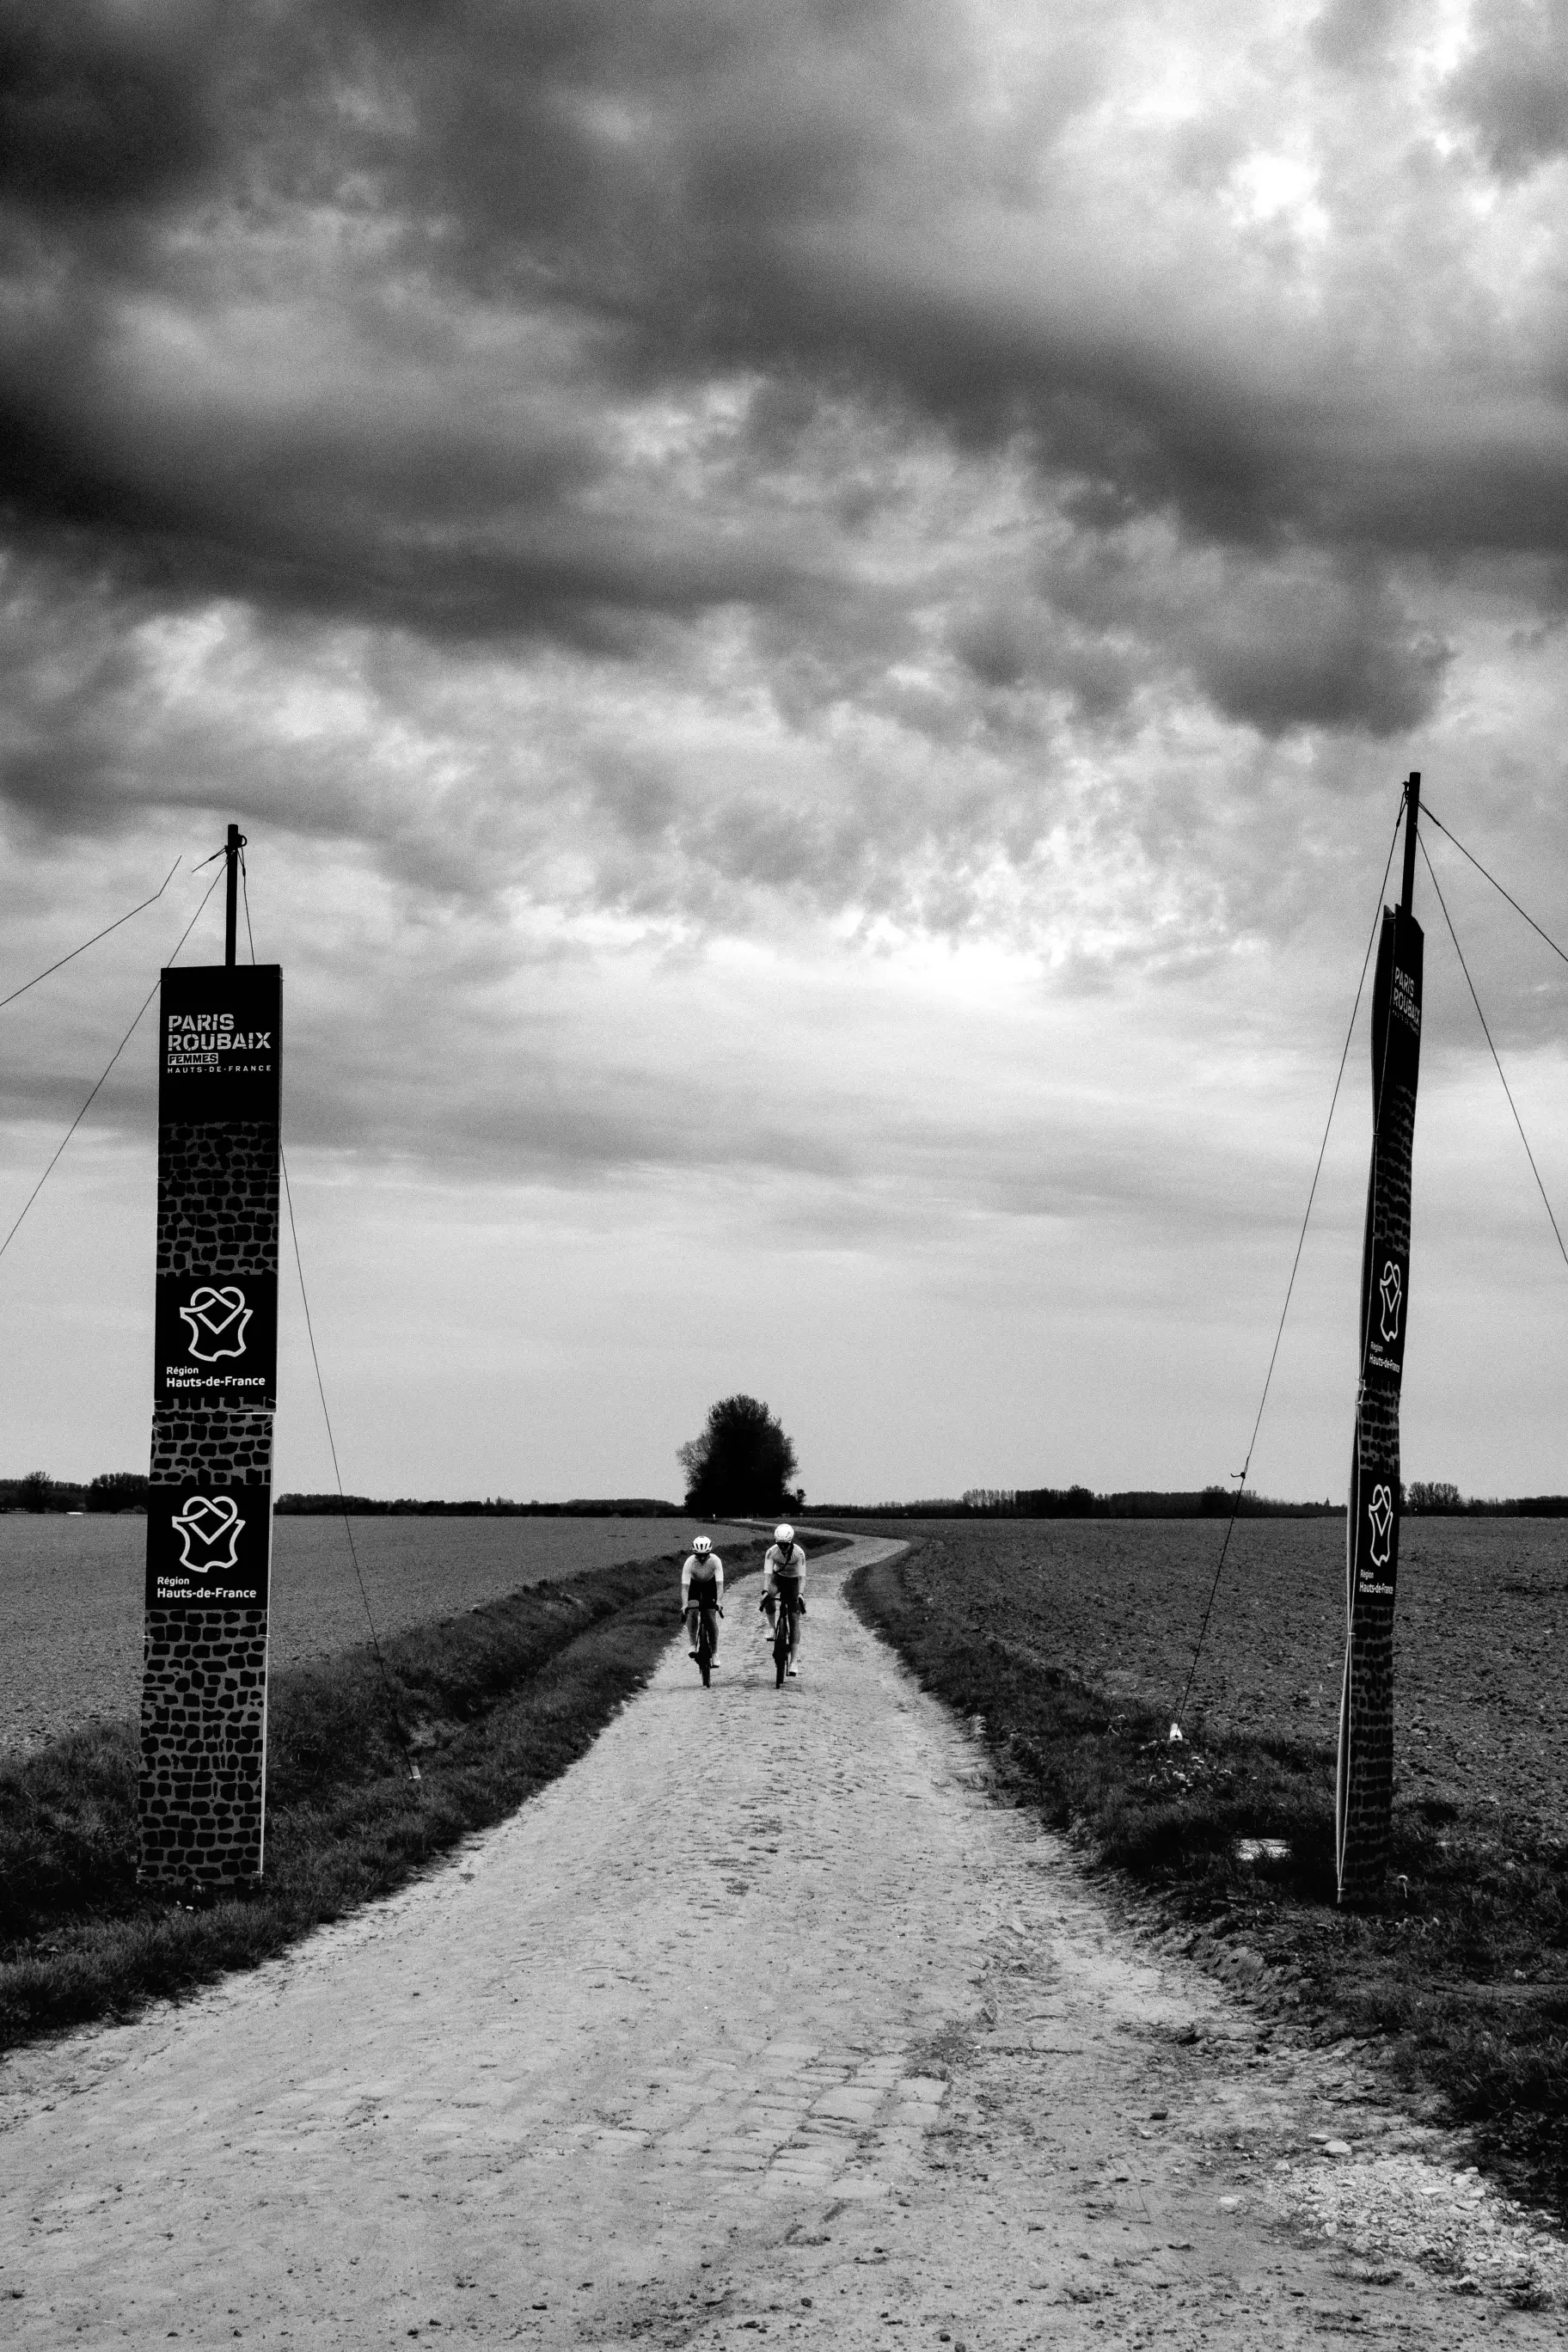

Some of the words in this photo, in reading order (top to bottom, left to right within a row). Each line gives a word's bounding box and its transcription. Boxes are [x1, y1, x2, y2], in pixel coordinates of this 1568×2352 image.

[1394, 966, 1414, 997] PARIS
[168, 1014, 235, 1032] PARIS
[168, 1032, 272, 1051] ROUBAIX
[168, 1054, 218, 1065] FEMMES
[167, 1065, 272, 1074] HAUTS-DE-FRANCE
[166, 1366, 199, 1375] Région
[166, 1376, 266, 1387] Hauts-de-France
[156, 1577, 190, 1586] Région
[156, 1588, 257, 1598] Hauts-de-France
